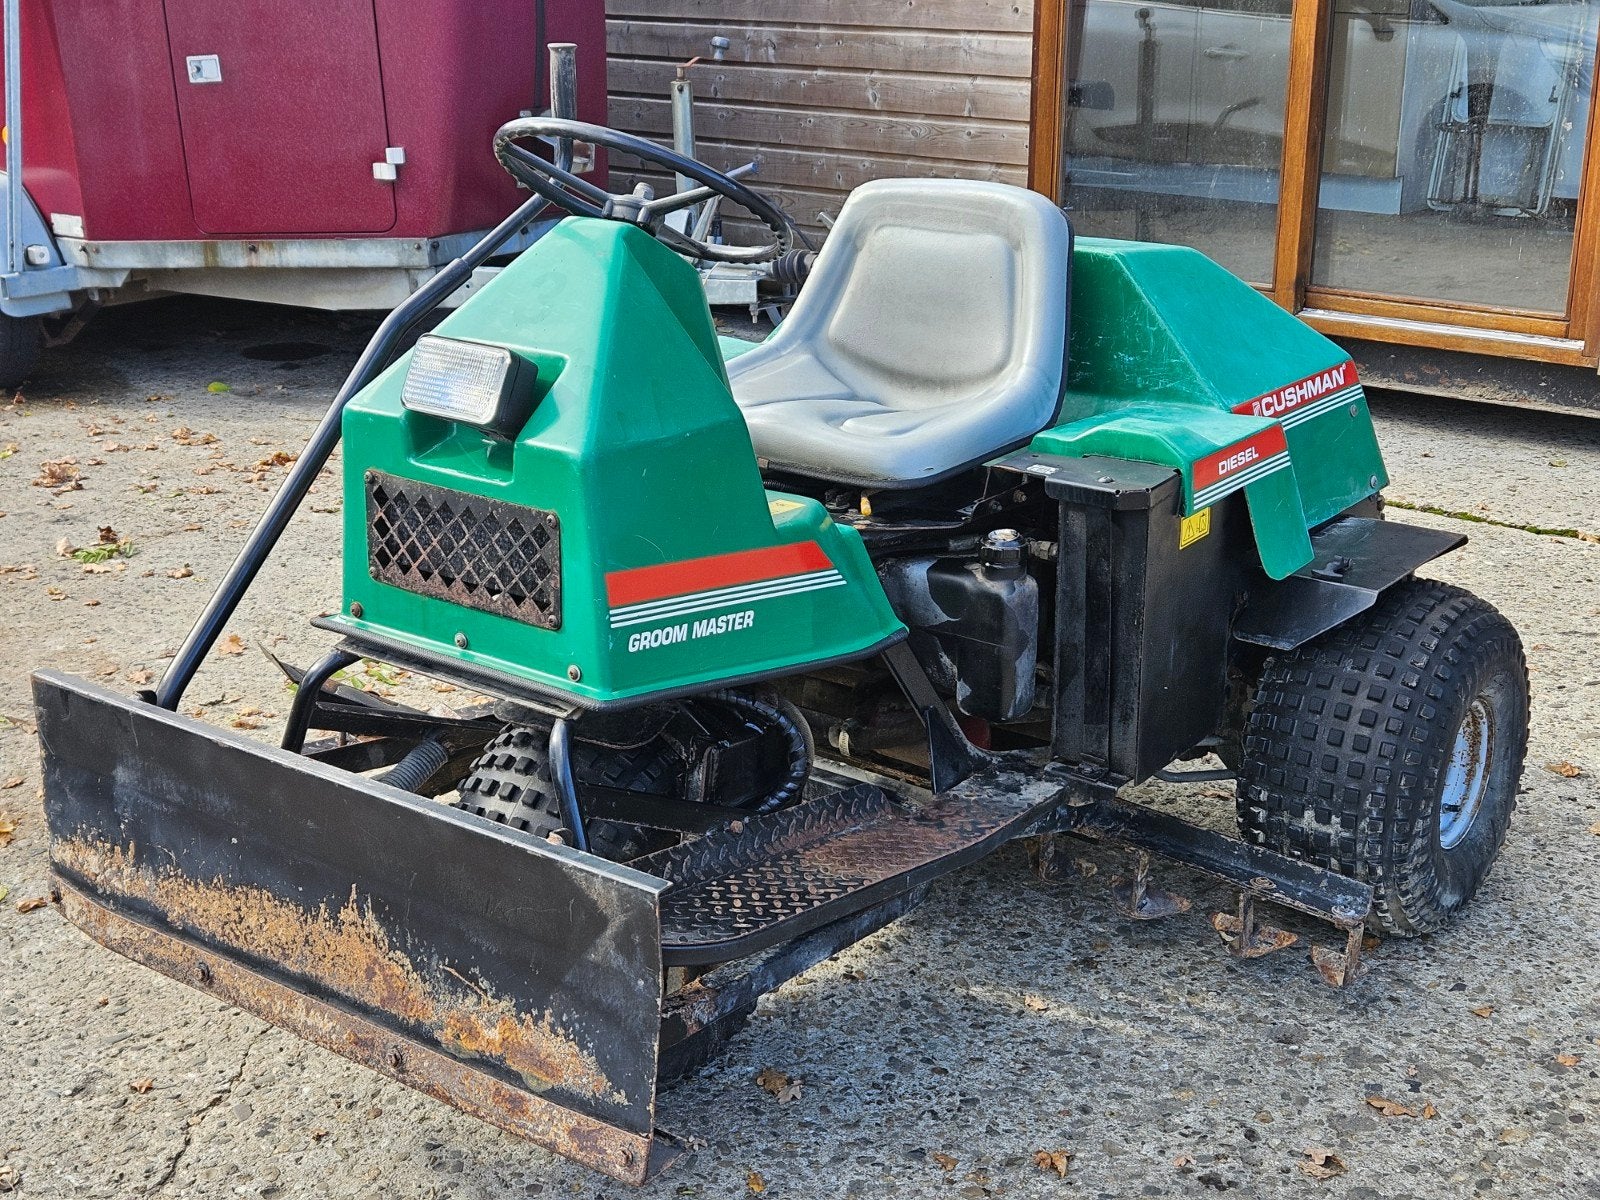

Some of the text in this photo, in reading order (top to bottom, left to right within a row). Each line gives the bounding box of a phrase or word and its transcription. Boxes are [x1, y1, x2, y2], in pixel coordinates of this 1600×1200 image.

[1261, 366, 1345, 417] CUSHMAN
[1218, 446, 1259, 475] DIESEL
[628, 610, 755, 652] GROOM MASTER
